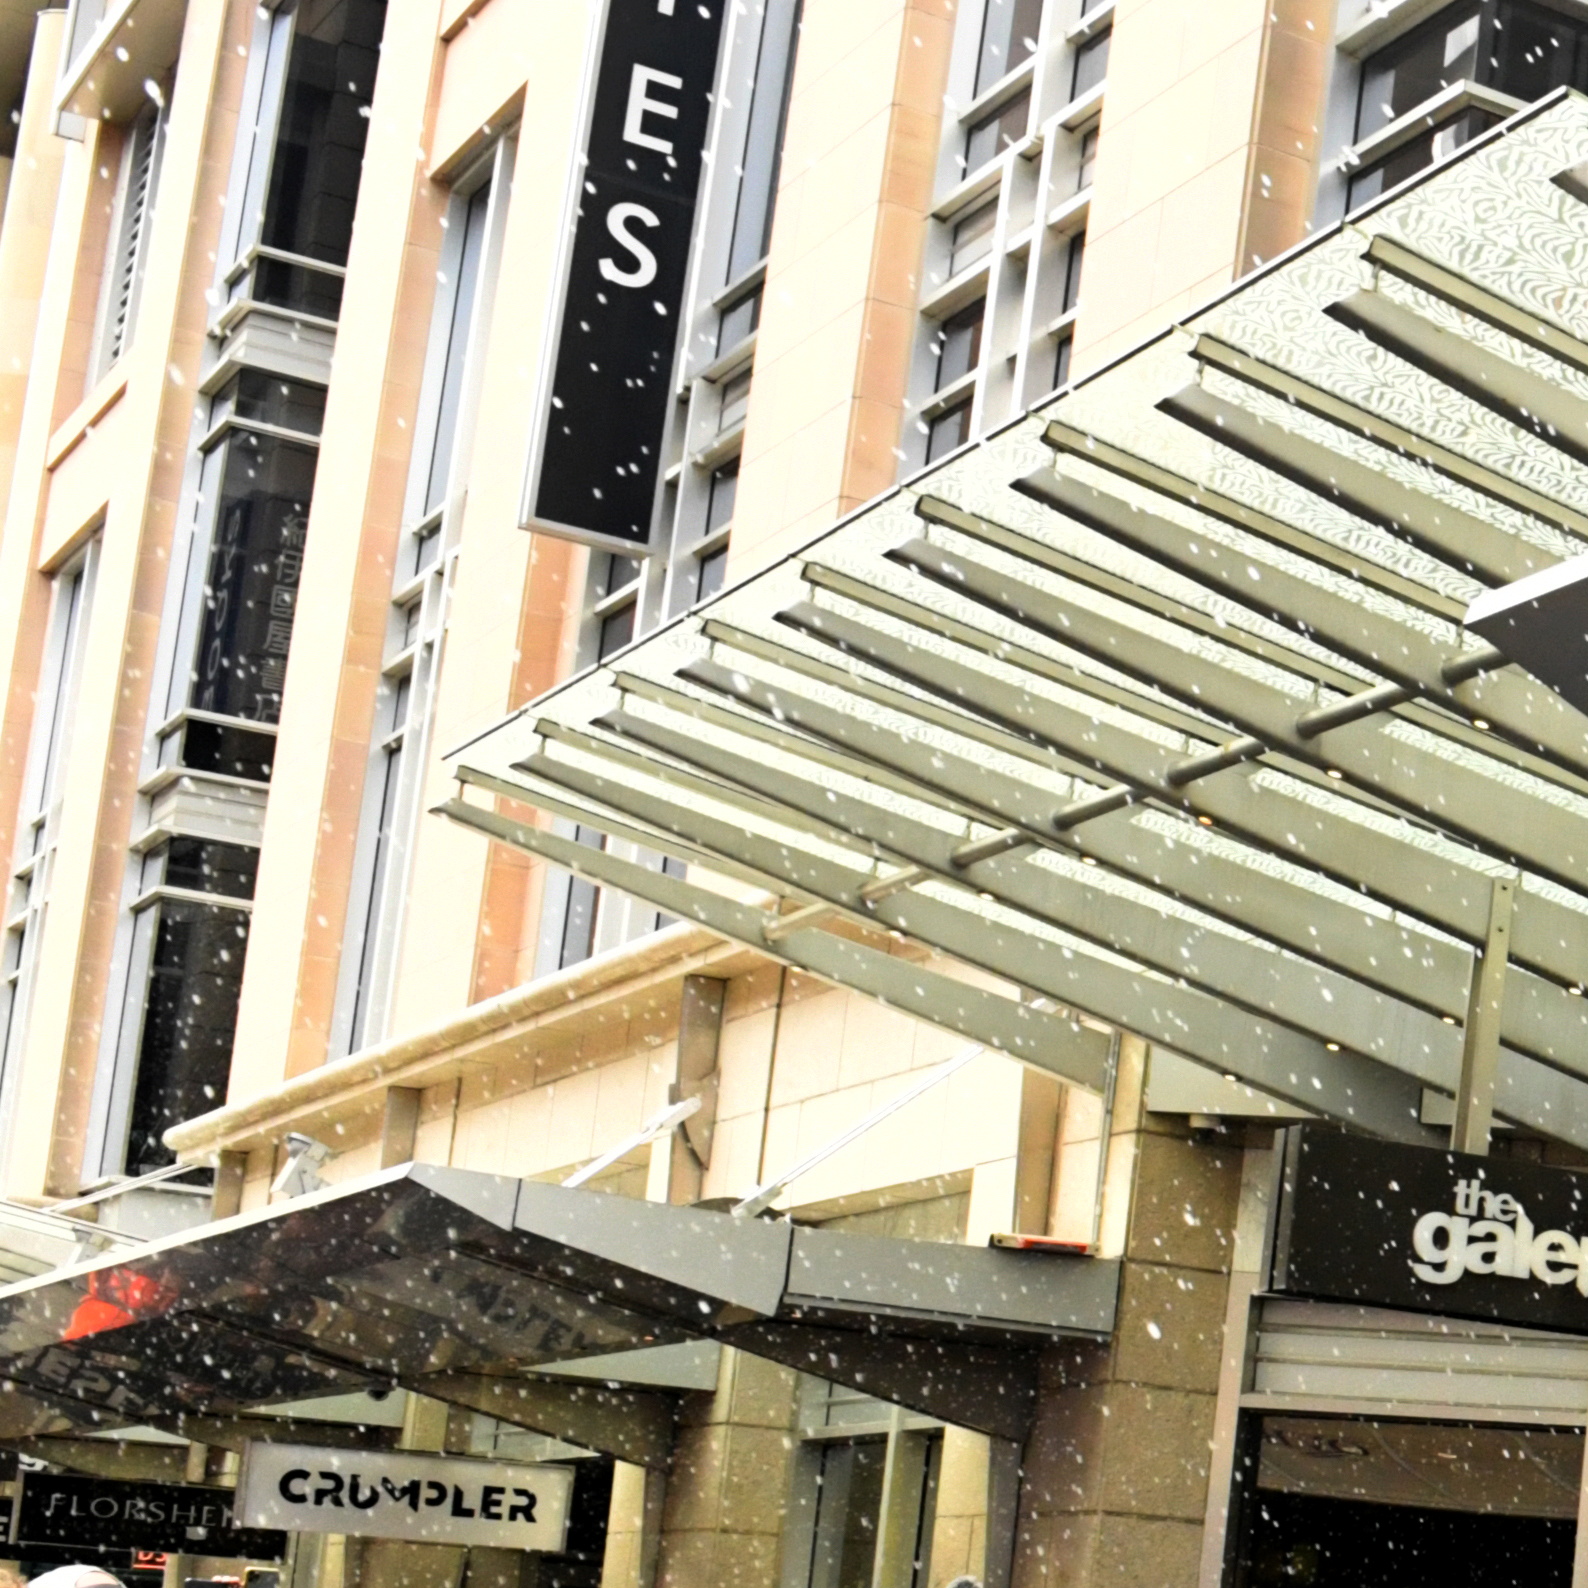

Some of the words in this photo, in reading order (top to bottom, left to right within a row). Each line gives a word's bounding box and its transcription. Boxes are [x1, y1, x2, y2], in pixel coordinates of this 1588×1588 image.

[599, 0, 683, 288] ES
[1453, 1179, 1521, 1222] the
[279, 1469, 537, 1523] CRUMPLER
